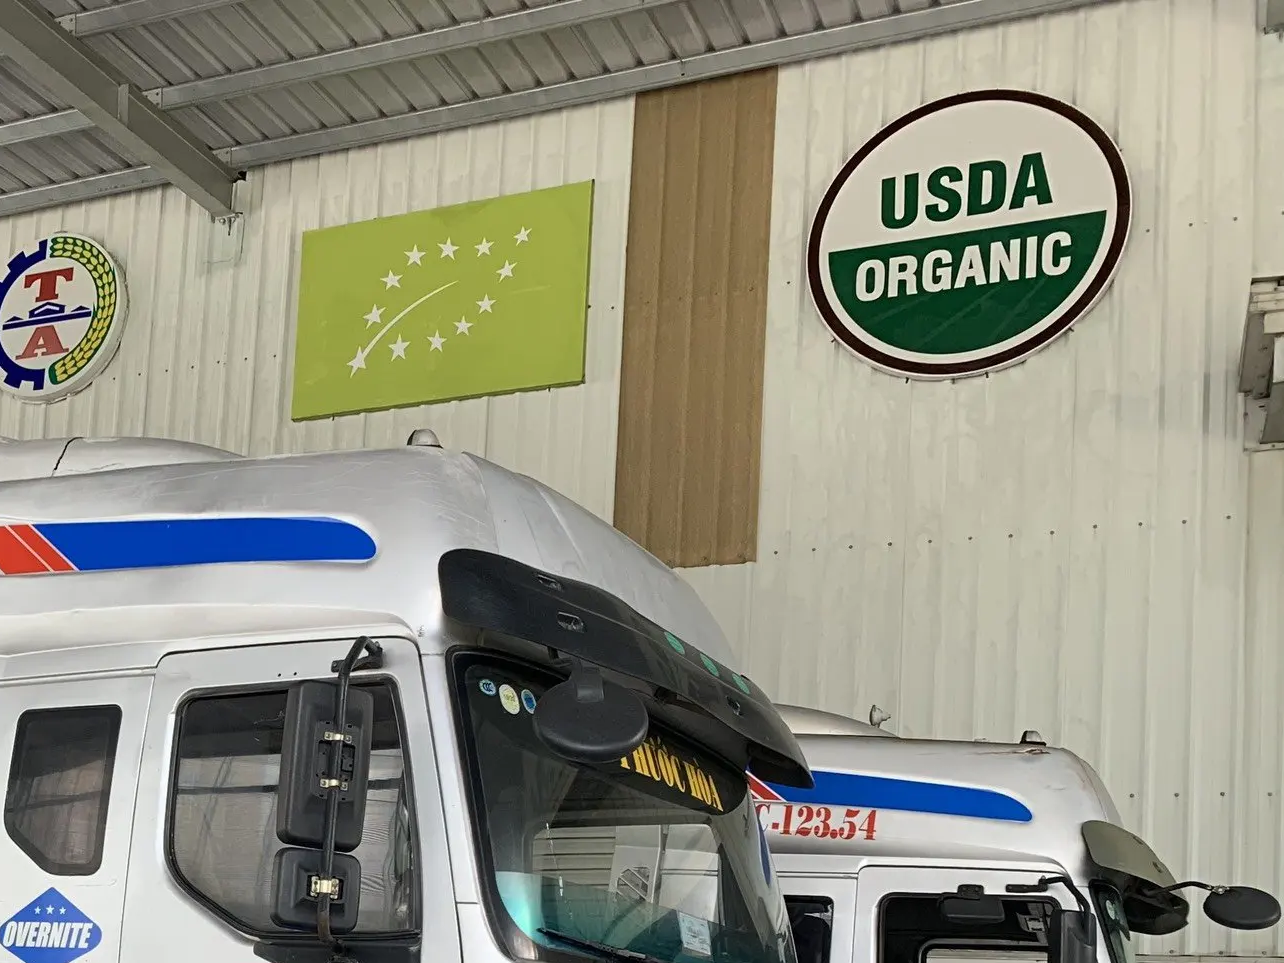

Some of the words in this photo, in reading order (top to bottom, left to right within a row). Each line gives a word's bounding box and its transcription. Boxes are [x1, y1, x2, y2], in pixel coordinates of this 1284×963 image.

[881, 152, 1053, 229] USDA
[855, 231, 1072, 302] ORGANIC
[24, 267, 74, 302] T
[16, 325, 69, 360] A
[2, 920, 93, 949] OVERNITE
